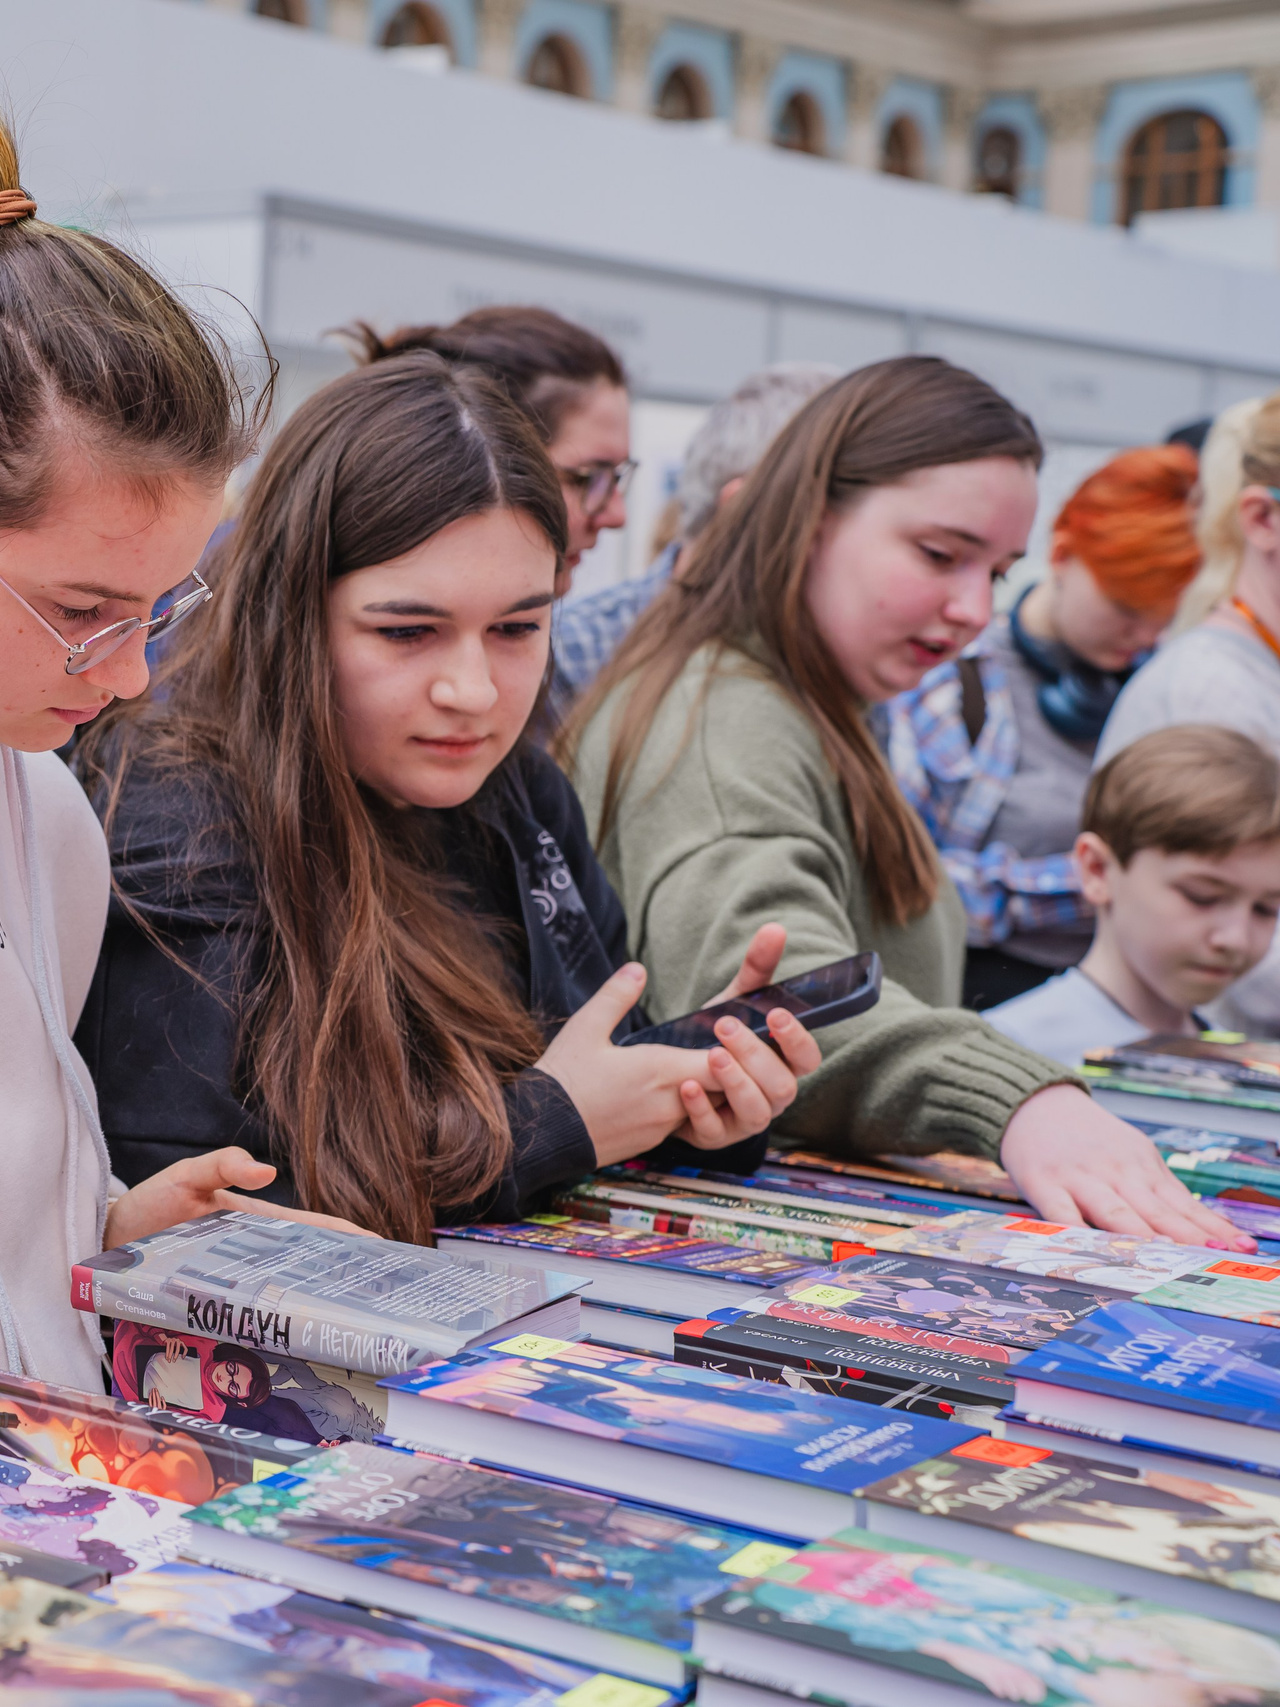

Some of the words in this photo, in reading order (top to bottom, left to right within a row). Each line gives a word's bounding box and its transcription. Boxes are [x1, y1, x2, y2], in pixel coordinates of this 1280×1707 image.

[115, 1301, 167, 1321] Степанова
[128, 1287, 154, 1302] Саша
[187, 1294, 292, 1350] КОЛДУН
[320, 1323, 410, 1375] НЕГЛИНКИ
[1098, 1328, 1177, 1373] ЛЮДИ
[825, 1348, 966, 1382] ПОДНЕБЕСНЫХ
[1141, 1334, 1236, 1388] БЕДНЫЕ
[126, 1401, 263, 1439] ЧУЧЕЛО
[348, 1472, 394, 1494] ОТ
[954, 1461, 1071, 1512] ИДИОТ
[283, 1489, 362, 1518] УМА
[341, 1488, 420, 1522] ГОРЕ
